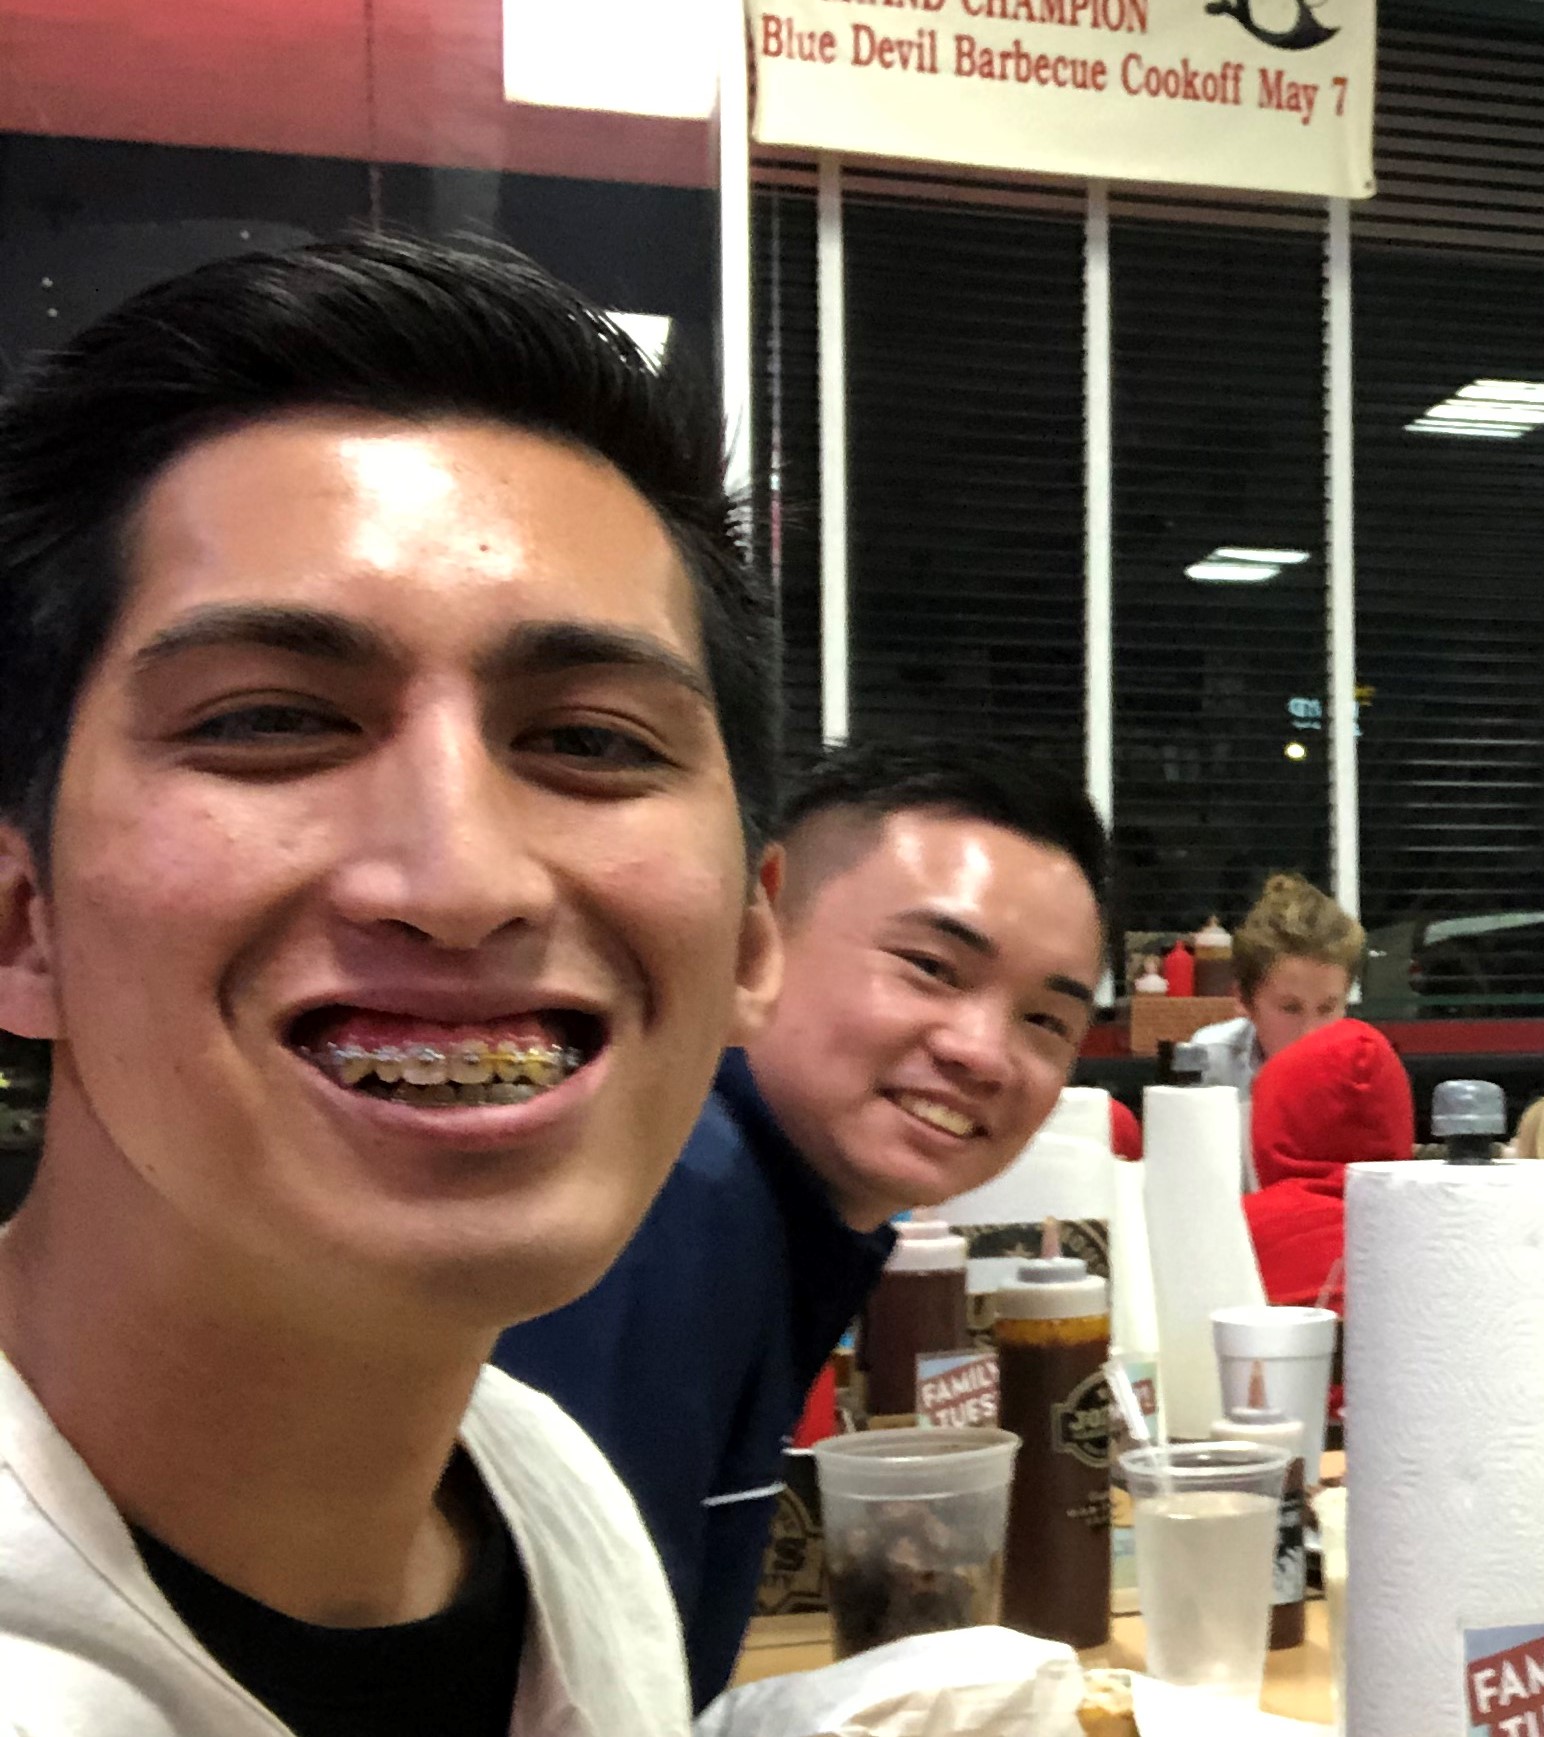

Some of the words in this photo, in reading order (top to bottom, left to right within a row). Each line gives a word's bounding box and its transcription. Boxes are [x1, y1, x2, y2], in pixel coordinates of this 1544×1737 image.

[762, 13, 837, 64] Blue
[851, 23, 938, 75] Devil
[954, 34, 1107, 91] Barbecue
[1120, 52, 1244, 106] Cookoff
[1257, 66, 1319, 126] May
[1331, 76, 1348, 117] 7
